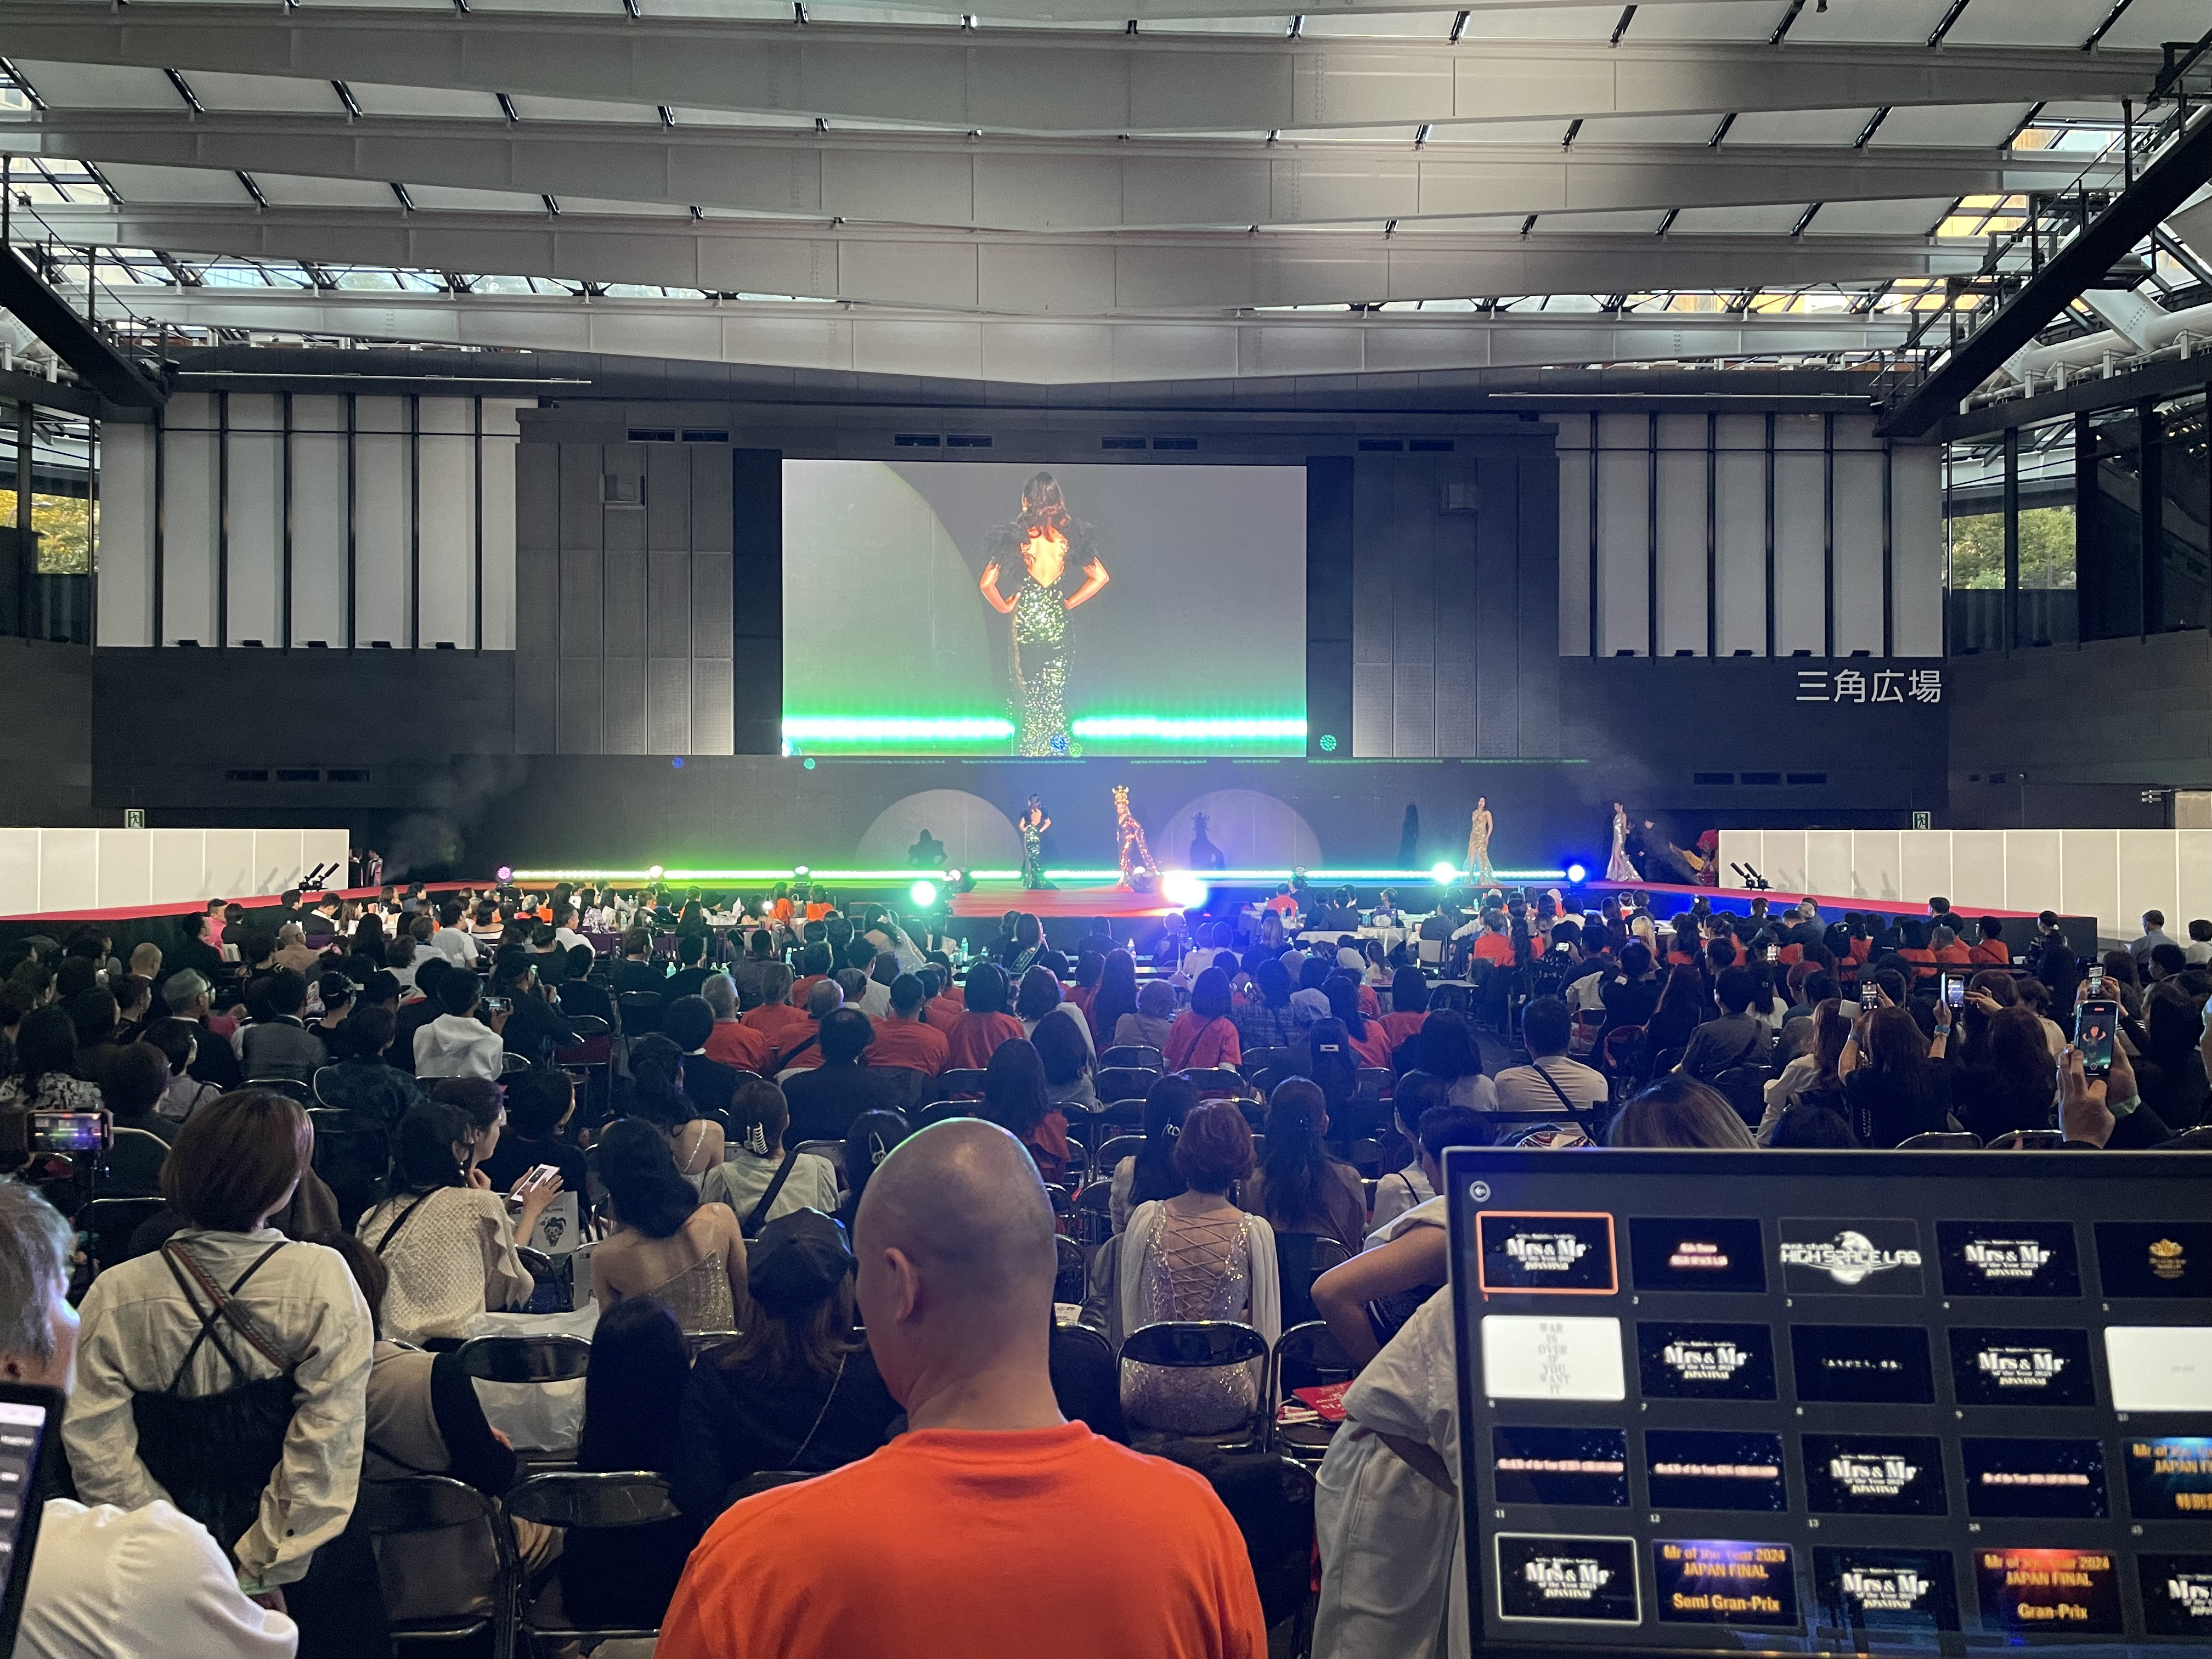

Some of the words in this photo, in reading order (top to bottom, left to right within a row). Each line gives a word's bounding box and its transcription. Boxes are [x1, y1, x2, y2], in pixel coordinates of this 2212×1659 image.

[1796, 669, 1942, 703] 三角広場
[1506, 1238, 1543, 1256] Mrs
[1558, 1239, 1587, 1257] Mr
[1965, 1245, 2005, 1261] Mrs
[2020, 1245, 2050, 1264] Mr
[1780, 1250, 1821, 1262] HIGH
[1822, 1250, 1881, 1263] SPACE
[1883, 1250, 1921, 1265] LAB
[1539, 1323, 1563, 1334] WAR
[1547, 1335, 1557, 1344] IS
[1538, 1344, 1567, 1355] OVER
[1664, 1346, 1701, 1363] Mrs
[1717, 1347, 1747, 1365] Mr
[1543, 1364, 1565, 1374] YOU
[1978, 1352, 2017, 1369] Mrs
[2033, 1353, 2064, 1371] Mr
[1539, 1374, 1570, 1384] WANT
[1830, 1459, 1870, 1477] Mrs
[1886, 1462, 1916, 1480] Mr
[1663, 1544, 1681, 1559] Mr
[1684, 1547, 1697, 1560] of
[1756, 1548, 1786, 1562] 2024
[1984, 1554, 2002, 1568] Mr
[2078, 1556, 2110, 1570] 2024
[1526, 1562, 1563, 1582] Mrs
[1579, 1565, 1609, 1584] Mr
[1684, 1562, 1726, 1577] JAPAN
[1729, 1564, 1769, 1579] FINAL
[2006, 1571, 2050, 1586] JAPAN
[2051, 1572, 2093, 1587] FINAL
[1842, 1573, 1882, 1592] Mrs
[1898, 1575, 1929, 1595] Mr
[2168, 1579, 2209, 1599] Mrs
[1673, 1592, 1709, 1610] Semi
[1712, 1593, 1780, 1611] Gran-Prix
[2017, 1602, 2088, 1620] Gran-Prix
